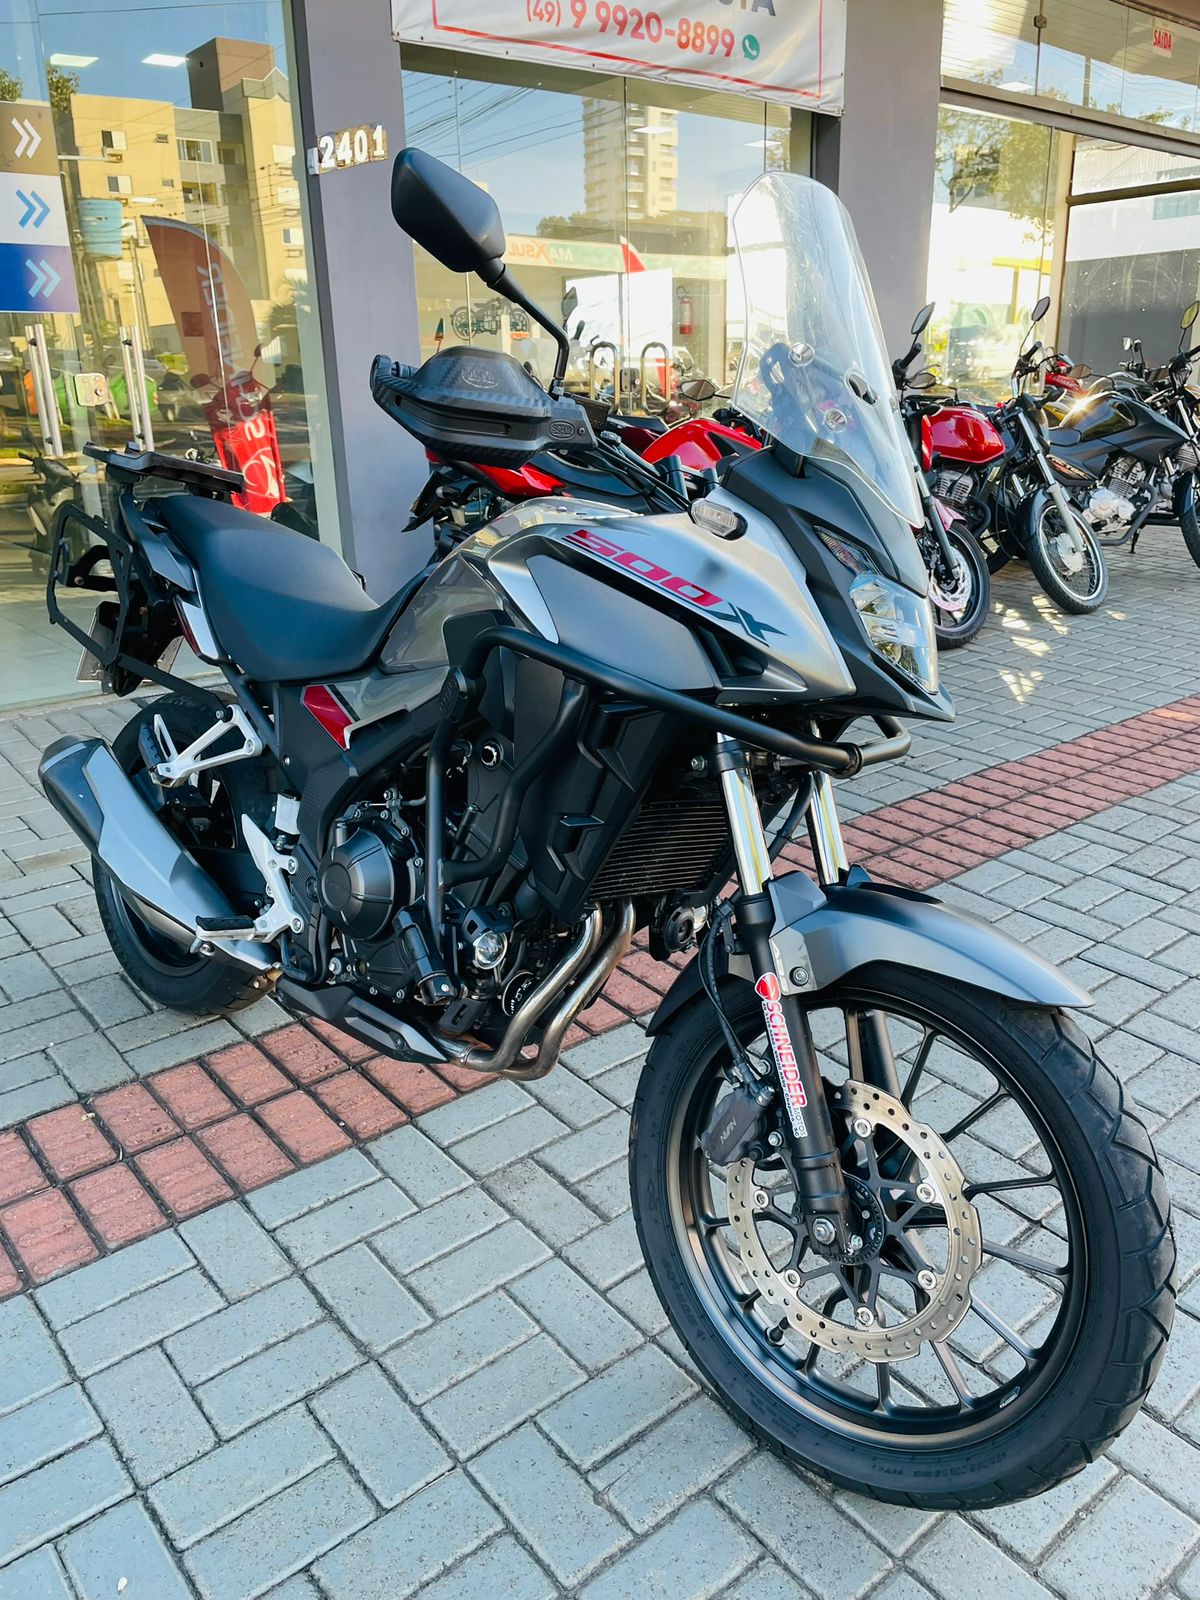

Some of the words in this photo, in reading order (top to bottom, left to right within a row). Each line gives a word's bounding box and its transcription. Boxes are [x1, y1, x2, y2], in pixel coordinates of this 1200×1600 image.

[526, 0, 562, 27] (49)
[570, 0, 587, 28] 9
[595, 2, 735, 57] 9920-8899
[319, 125, 385, 168] 2401
[767, 1001, 807, 1108] SCHNEIDER
[793, 1107, 807, 1136] MOTOS
